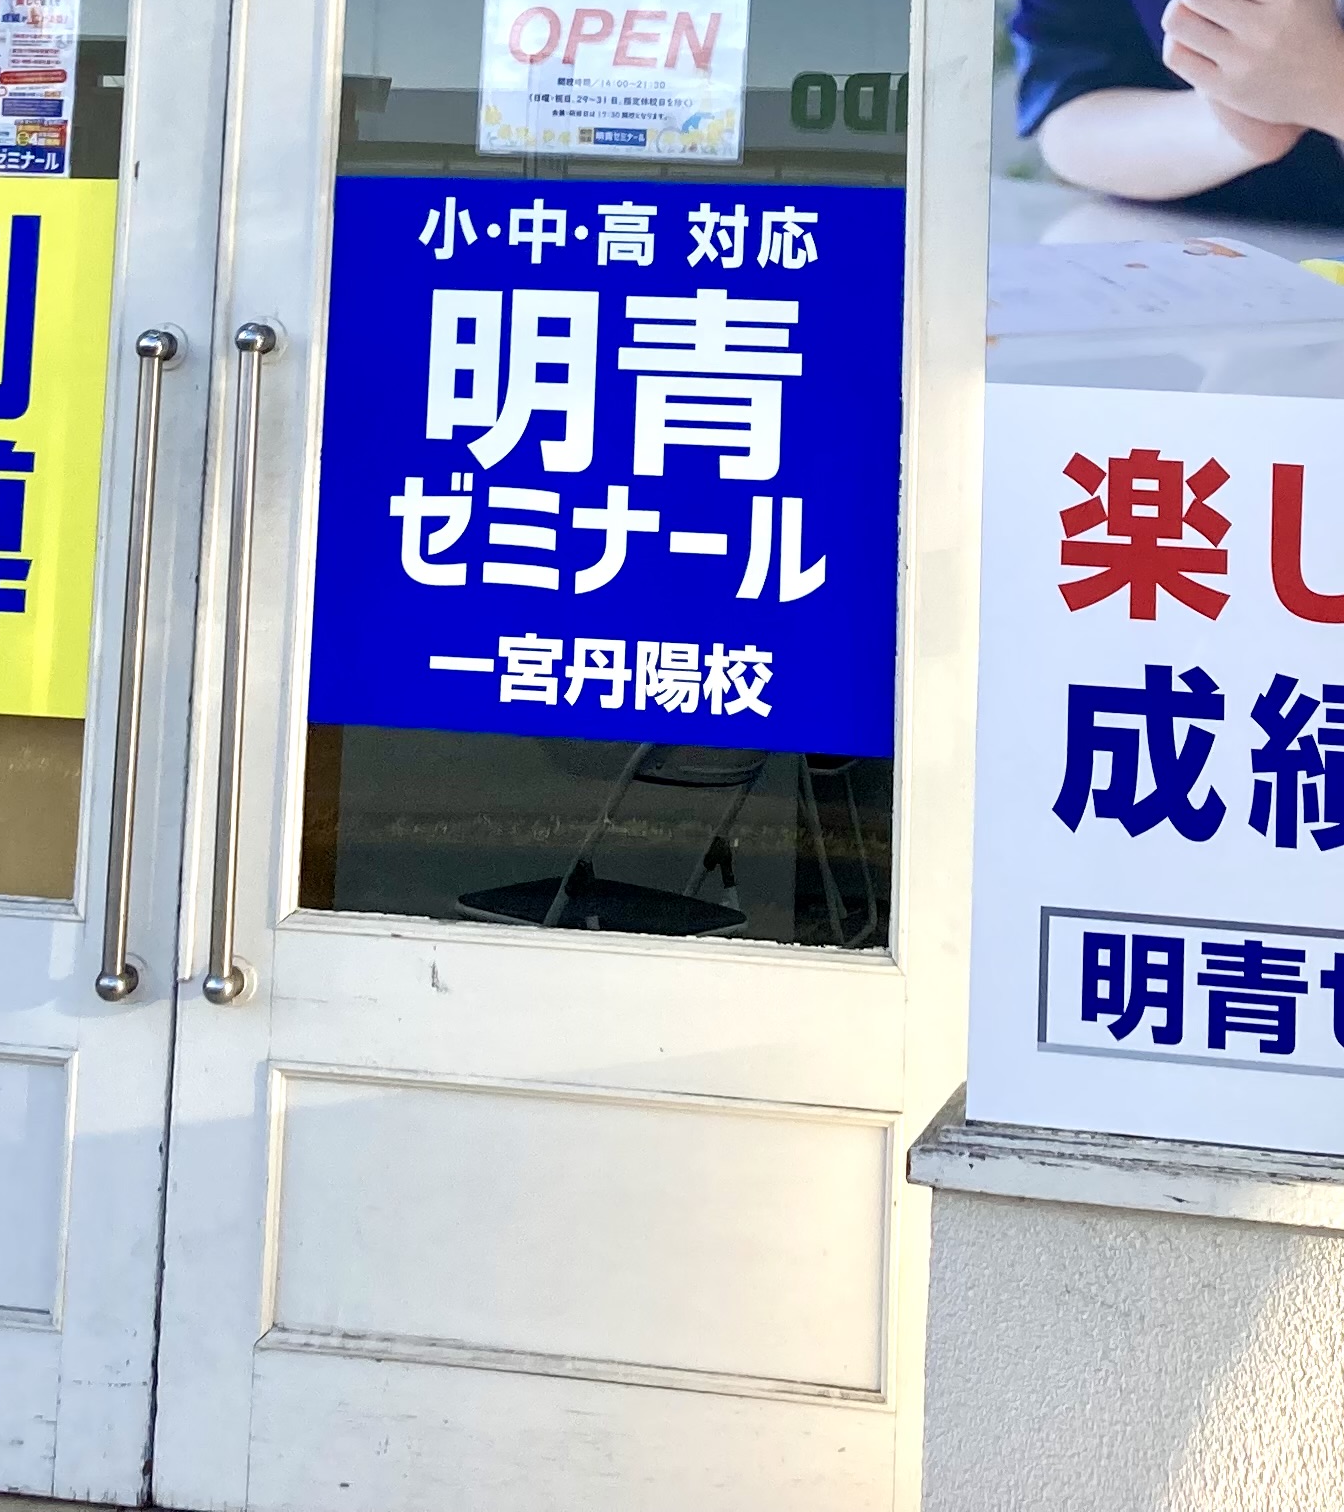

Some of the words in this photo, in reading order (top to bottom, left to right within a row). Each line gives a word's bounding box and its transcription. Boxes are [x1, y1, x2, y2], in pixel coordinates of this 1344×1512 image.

[508, 6, 722, 71] OPEN
[418, 197, 658, 267] 小・中・高
[686, 203, 819, 270] 対応
[425, 288, 803, 481] 明青
[389, 472, 826, 603] ゼミナール
[429, 632, 774, 717] 一宮丹陽校
